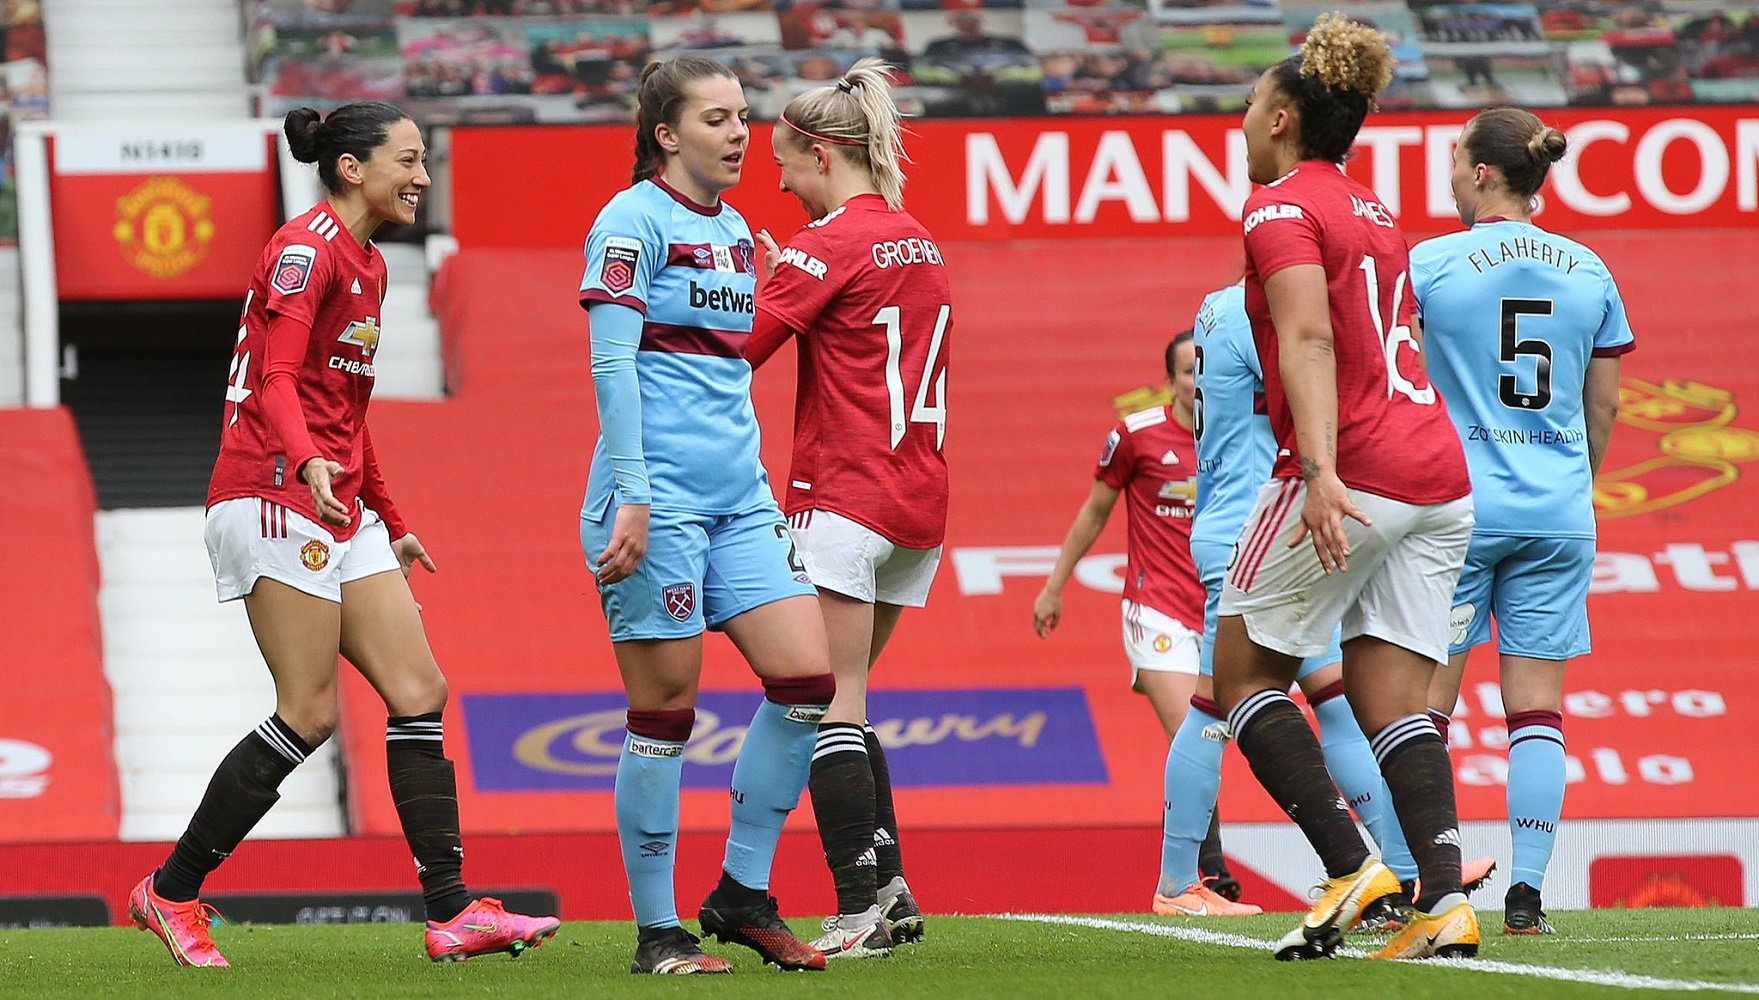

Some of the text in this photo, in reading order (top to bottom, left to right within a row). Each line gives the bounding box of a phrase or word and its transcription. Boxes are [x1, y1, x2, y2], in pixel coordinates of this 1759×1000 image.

[778, 247, 829, 281] OHLER
[872, 237, 945, 270] GROENEN
[1468, 237, 1579, 275] FLAHERTY
[689, 280, 754, 315] betwa
[1359, 254, 1436, 405] 16
[1499, 298, 1553, 410] 5
[872, 305, 950, 452] 14
[1494, 428, 1525, 445] SKIN
[1529, 429, 1584, 445] HEALTH
[1155, 504, 1195, 519] CHEV
[512, 703, 1047, 777] Caury
[632, 740, 683, 756] bartercar
[730, 786, 745, 804] HU
[1350, 792, 1371, 808] HU
[1516, 817, 1553, 833] WHU
